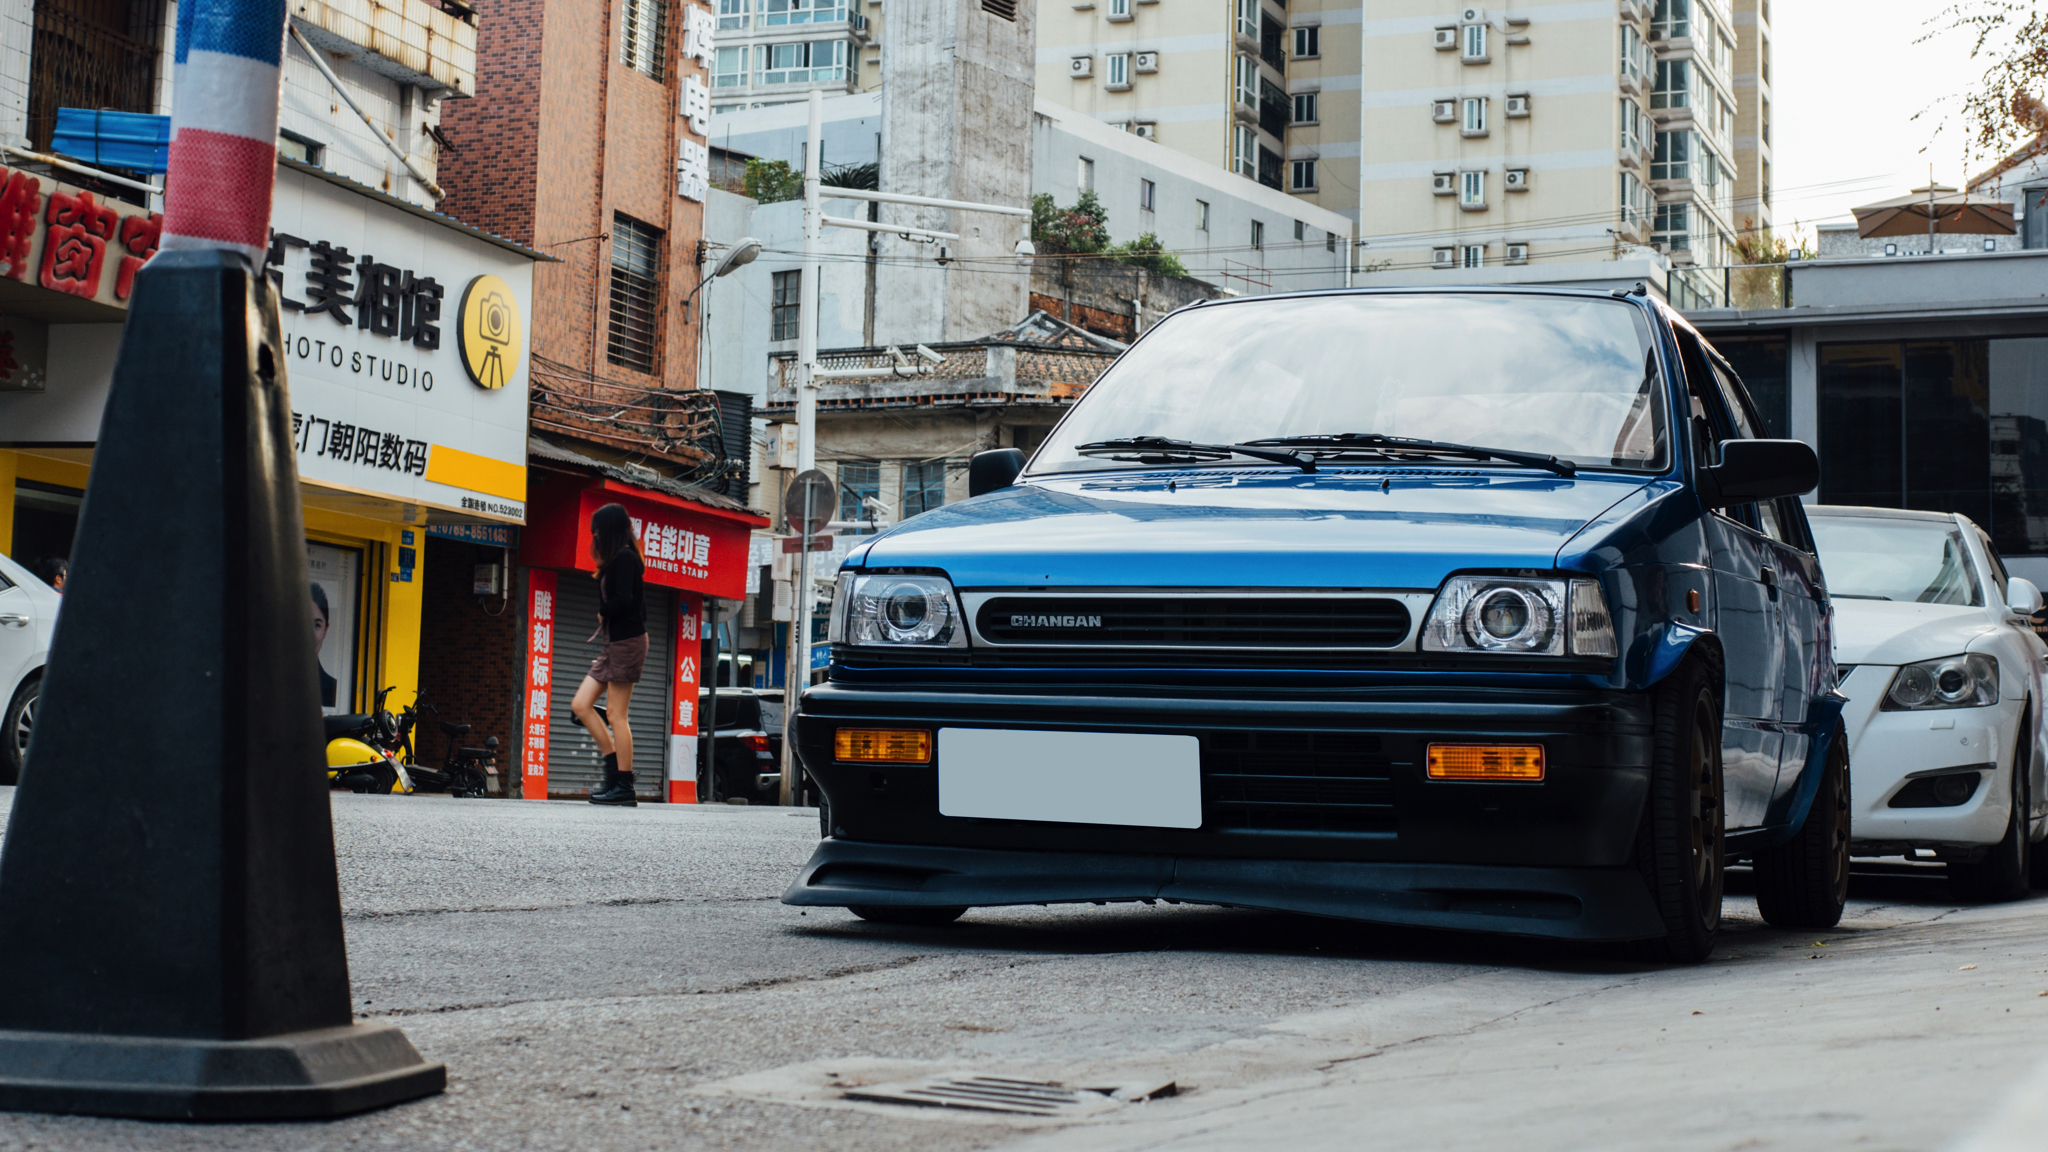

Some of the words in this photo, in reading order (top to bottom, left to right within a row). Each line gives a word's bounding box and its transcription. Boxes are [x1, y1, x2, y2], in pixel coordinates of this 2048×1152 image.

[351, 351, 434, 392] STUDIO
[643, 521, 710, 568] 佳能印章
[681, 565, 708, 580] STAMP
[1010, 615, 1102, 627] CHANGAN
[530, 590, 553, 720] 雕刻标牌
[678, 612, 697, 728] 刻公章
